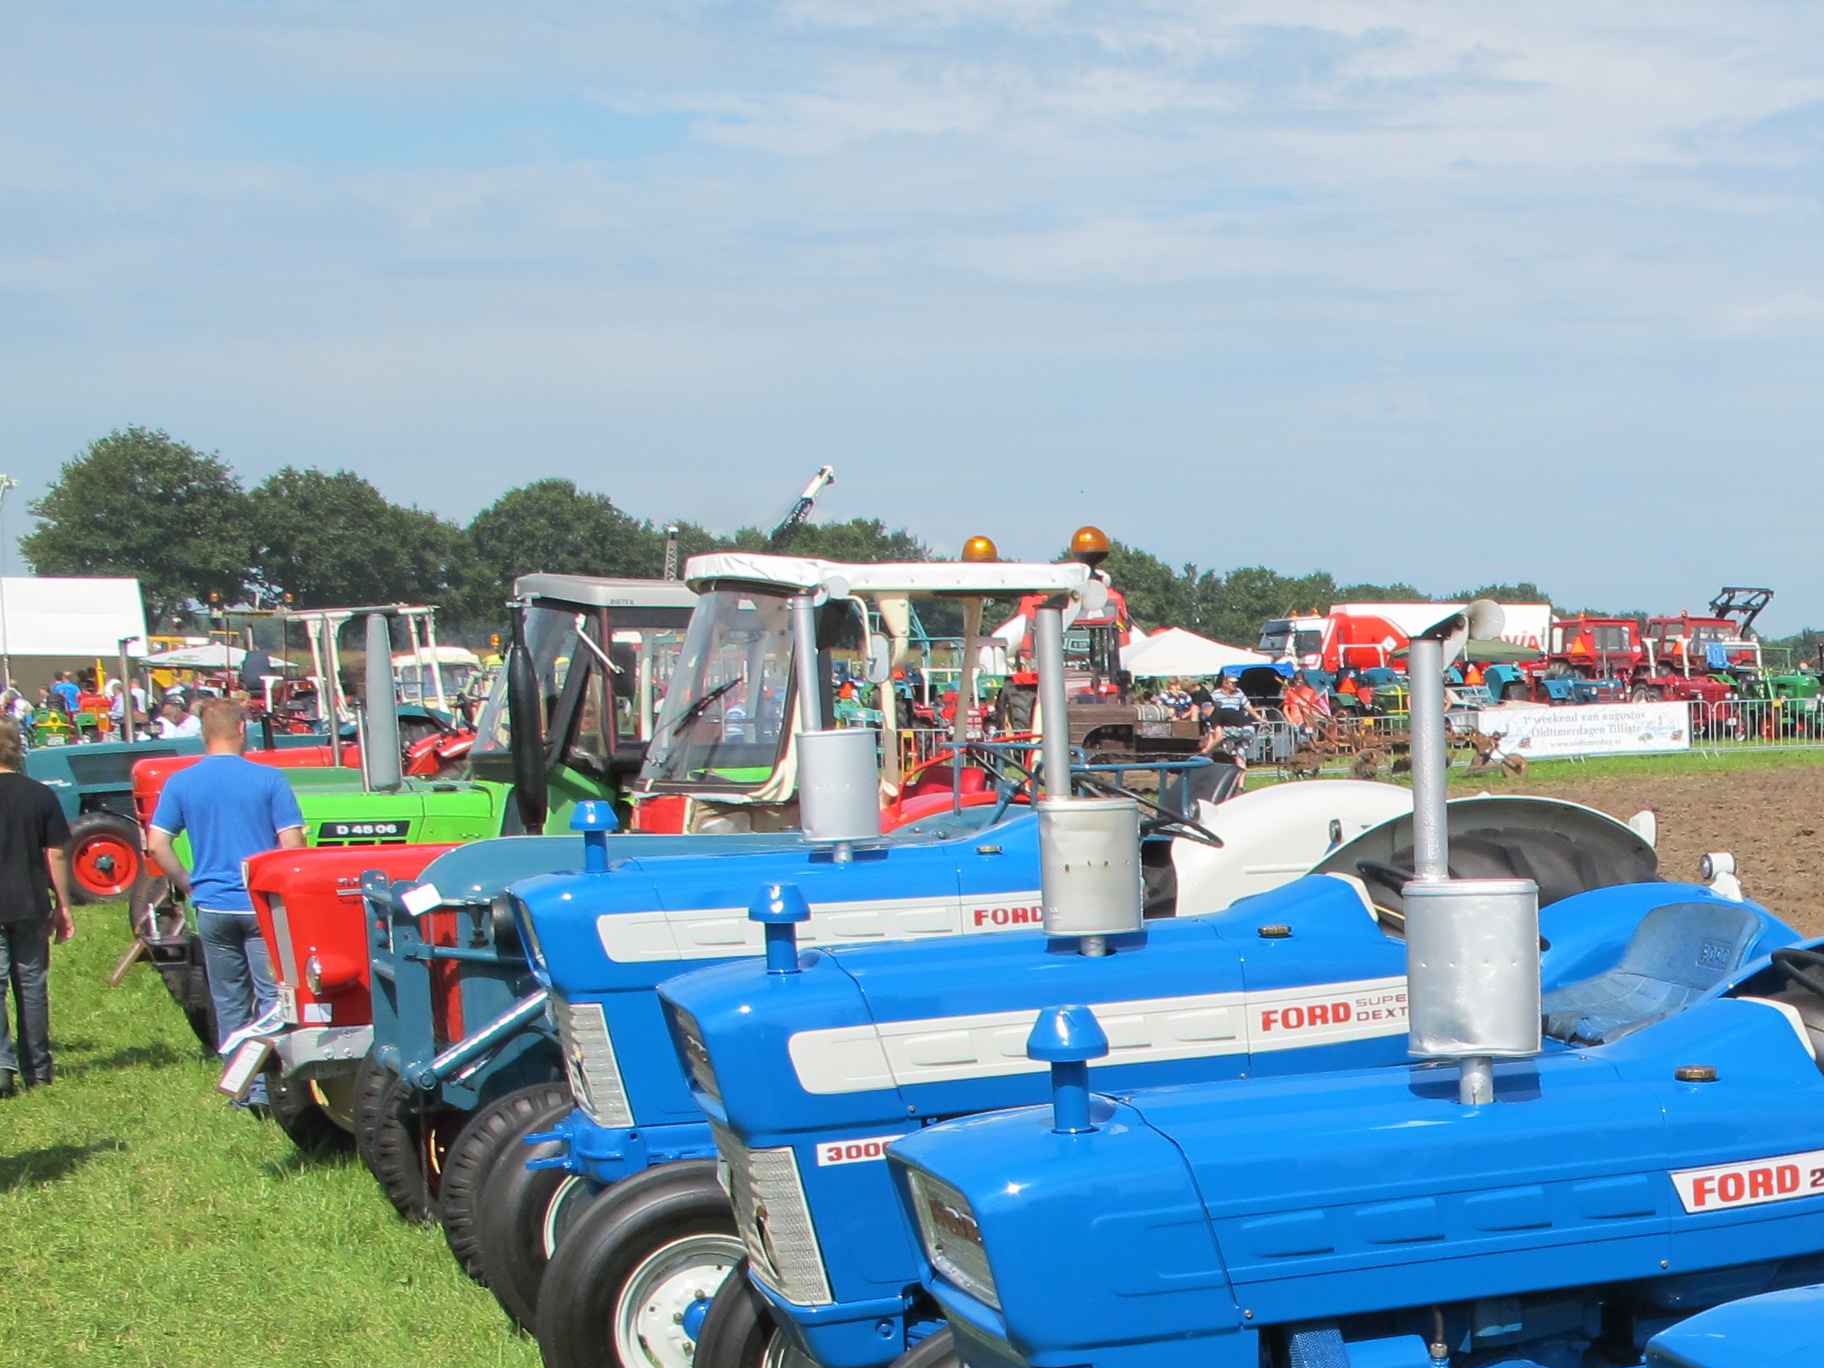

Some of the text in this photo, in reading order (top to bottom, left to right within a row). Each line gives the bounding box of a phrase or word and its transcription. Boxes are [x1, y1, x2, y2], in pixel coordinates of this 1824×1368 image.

[1533, 712, 1577, 724] weekend
[1581, 713, 1599, 722] van
[1602, 711, 1646, 722] augustus
[1531, 725, 1605, 738] Oldtimerdagen
[1607, 723, 1641, 735] Tilligte
[336, 824, 398, 835] D 4506
[974, 906, 1045, 927] FORD
[1355, 993, 1407, 1007] SUPE
[1261, 1002, 1352, 1032] FORD
[1356, 1006, 1409, 1022] DEXT
[1692, 1164, 1800, 1207] FORD
